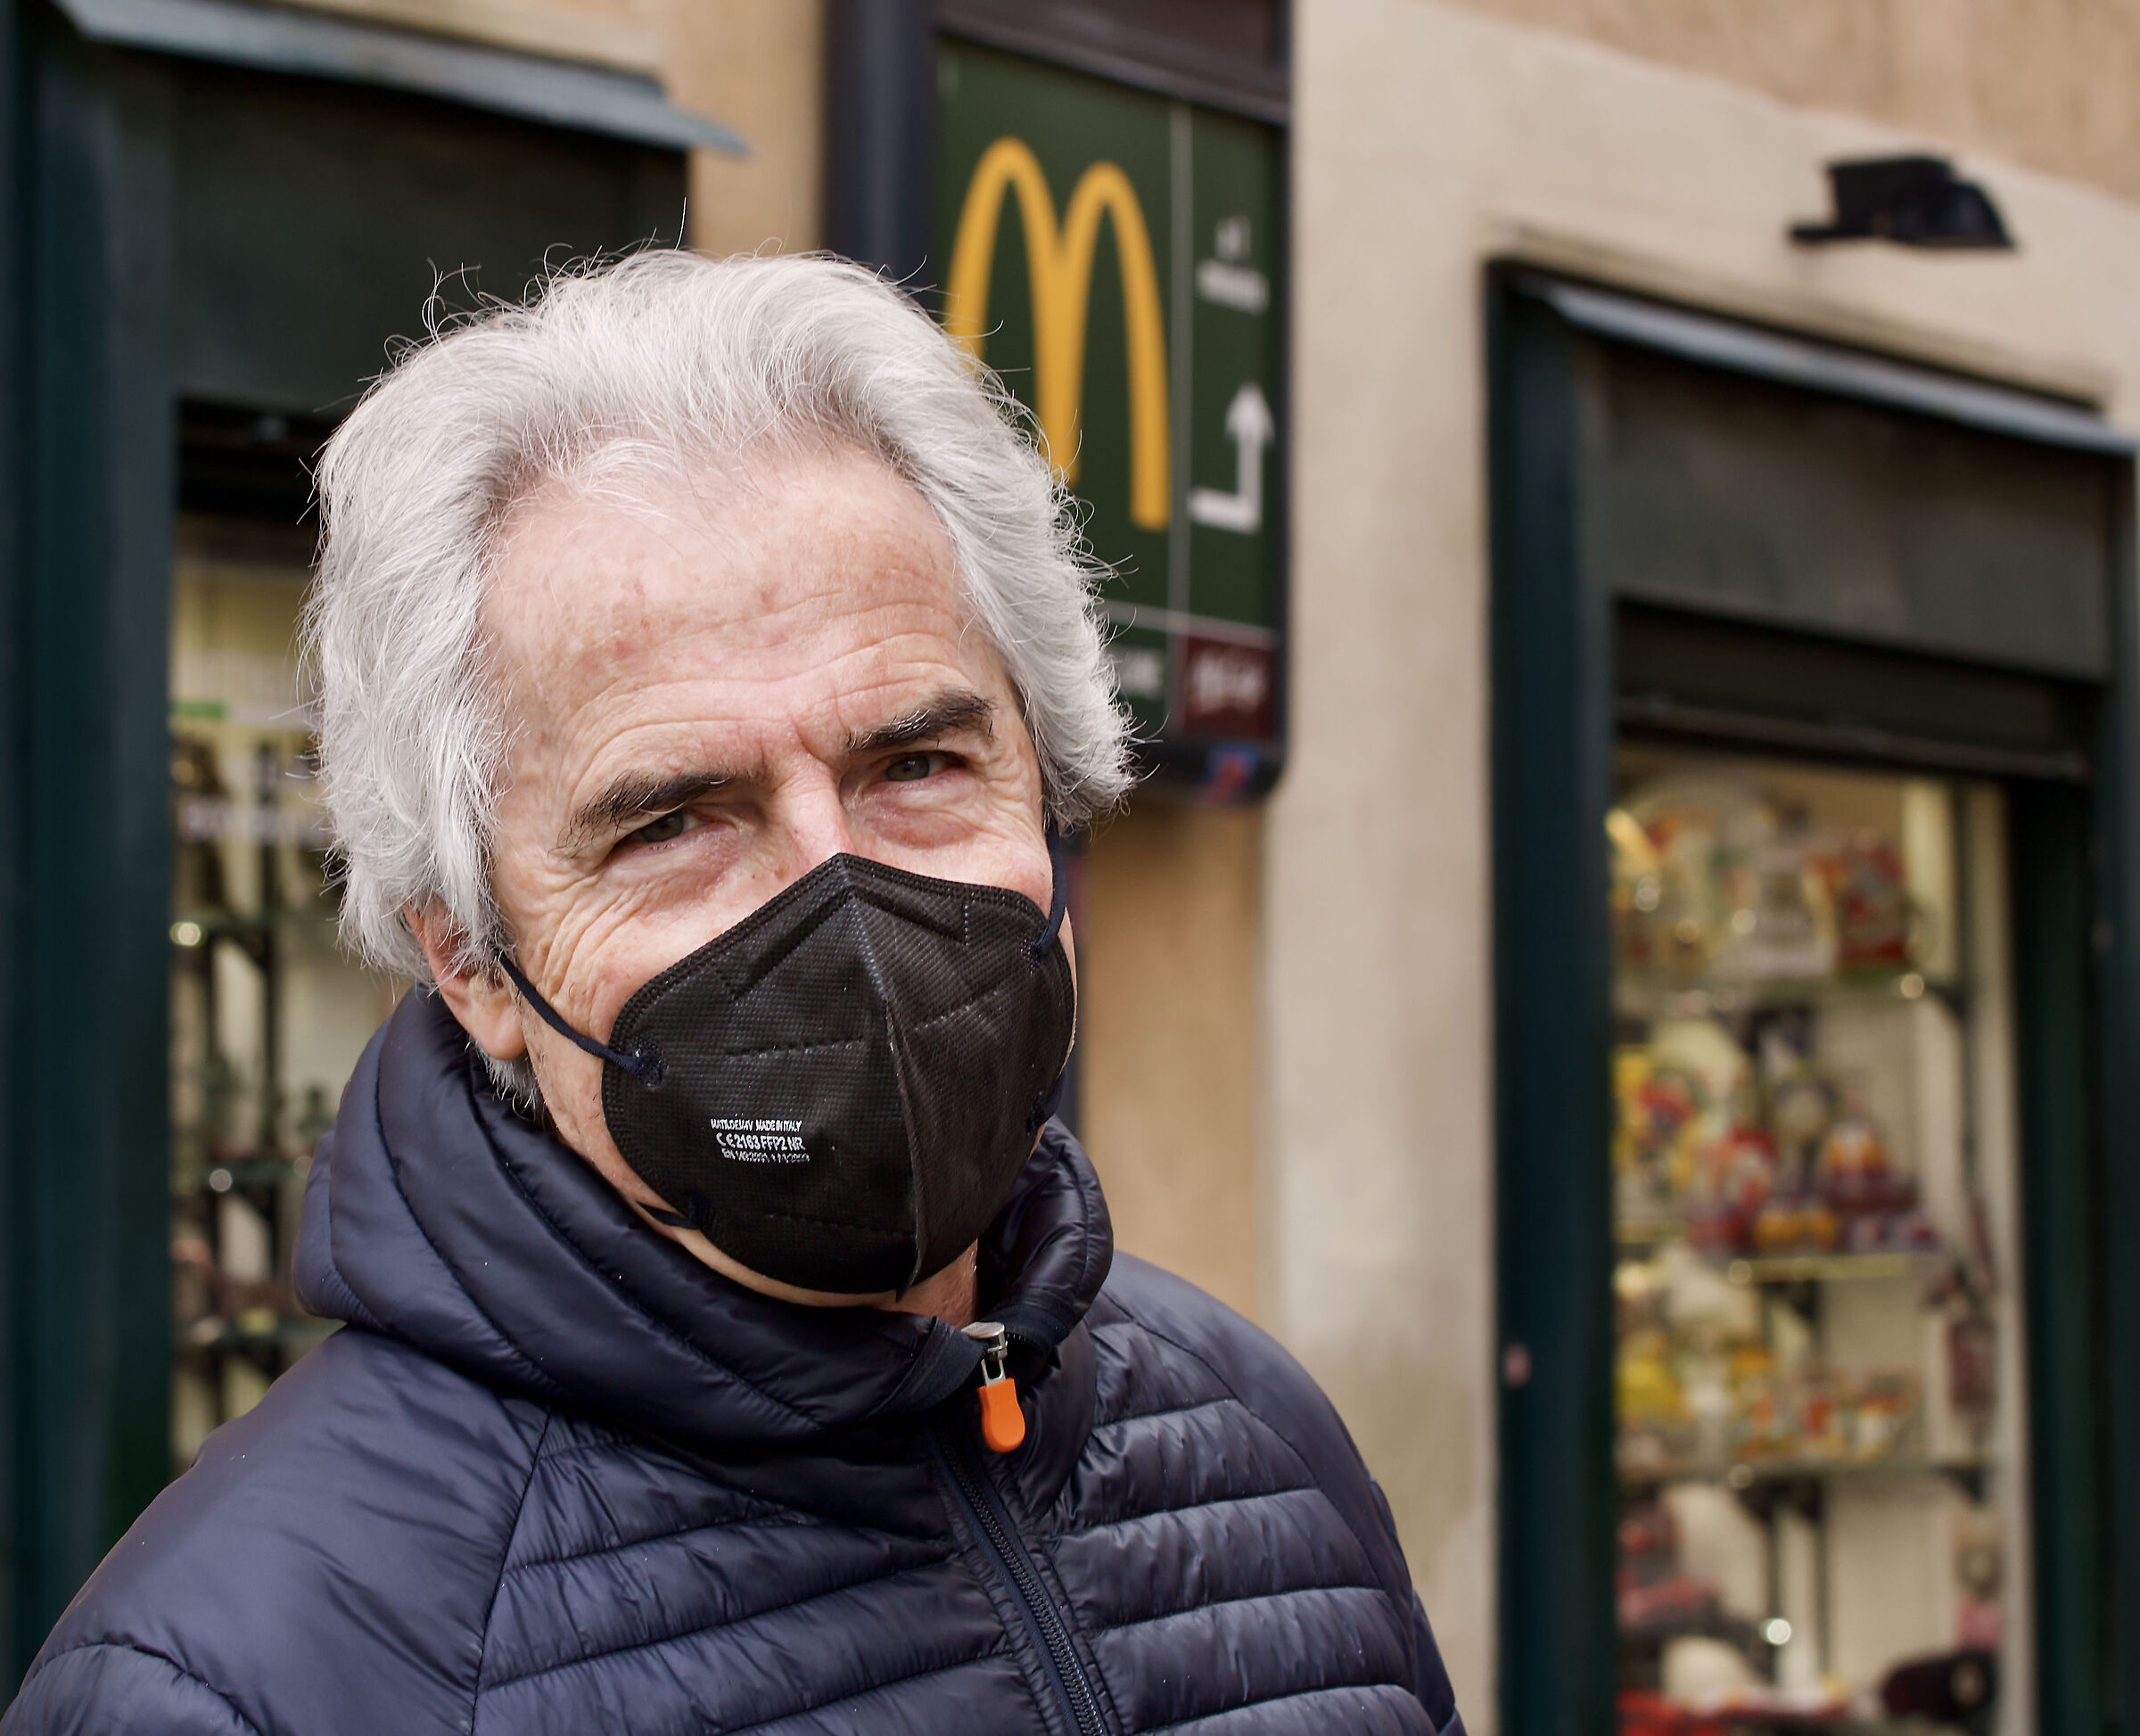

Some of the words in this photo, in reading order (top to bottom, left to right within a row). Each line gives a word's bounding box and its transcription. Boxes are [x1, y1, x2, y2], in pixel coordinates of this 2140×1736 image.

[755, 1119, 776, 1132] MADE
[776, 1119, 783, 1132] IN
[783, 1119, 802, 1132] ITALY
[761, 1134, 787, 1151] FFP2
[786, 1136, 806, 1151] NR
